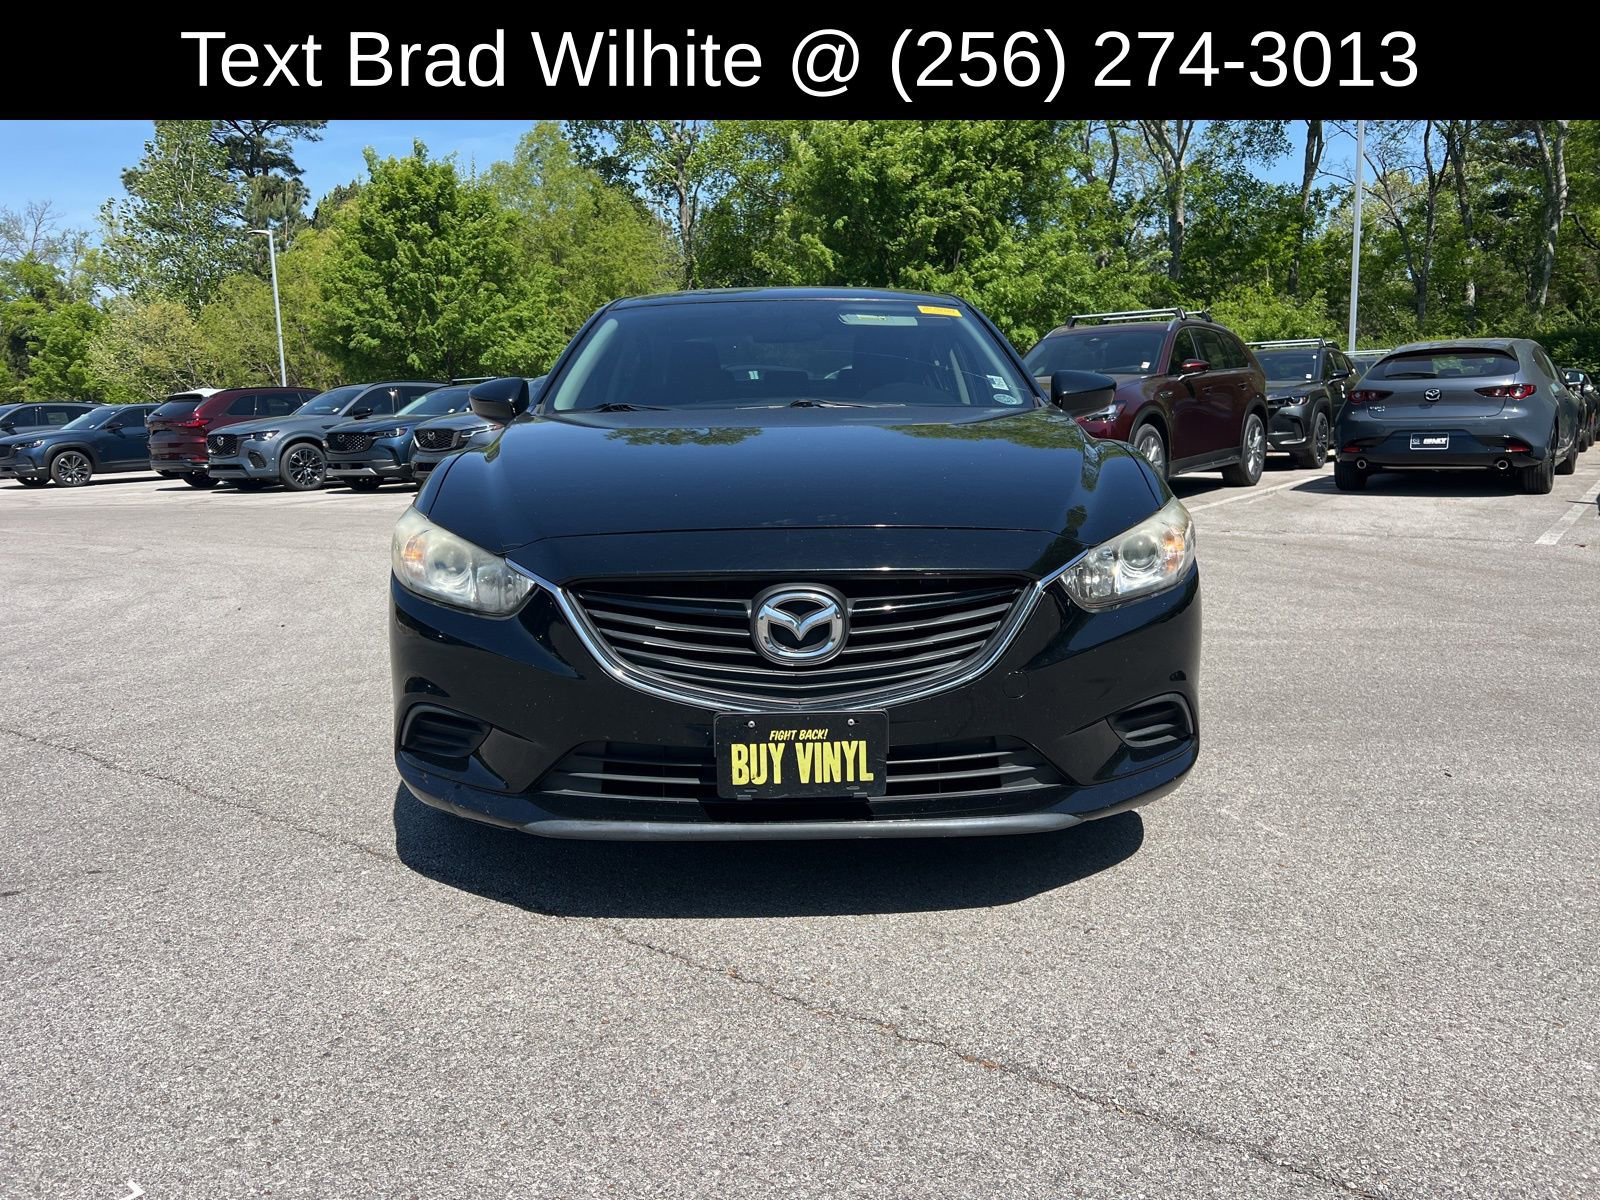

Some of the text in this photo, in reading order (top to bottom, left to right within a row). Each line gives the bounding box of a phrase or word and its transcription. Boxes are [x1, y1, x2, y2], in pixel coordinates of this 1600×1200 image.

[769, 728, 829, 741] FIGHT BACK!
[730, 740, 874, 785] BUY VINYL
